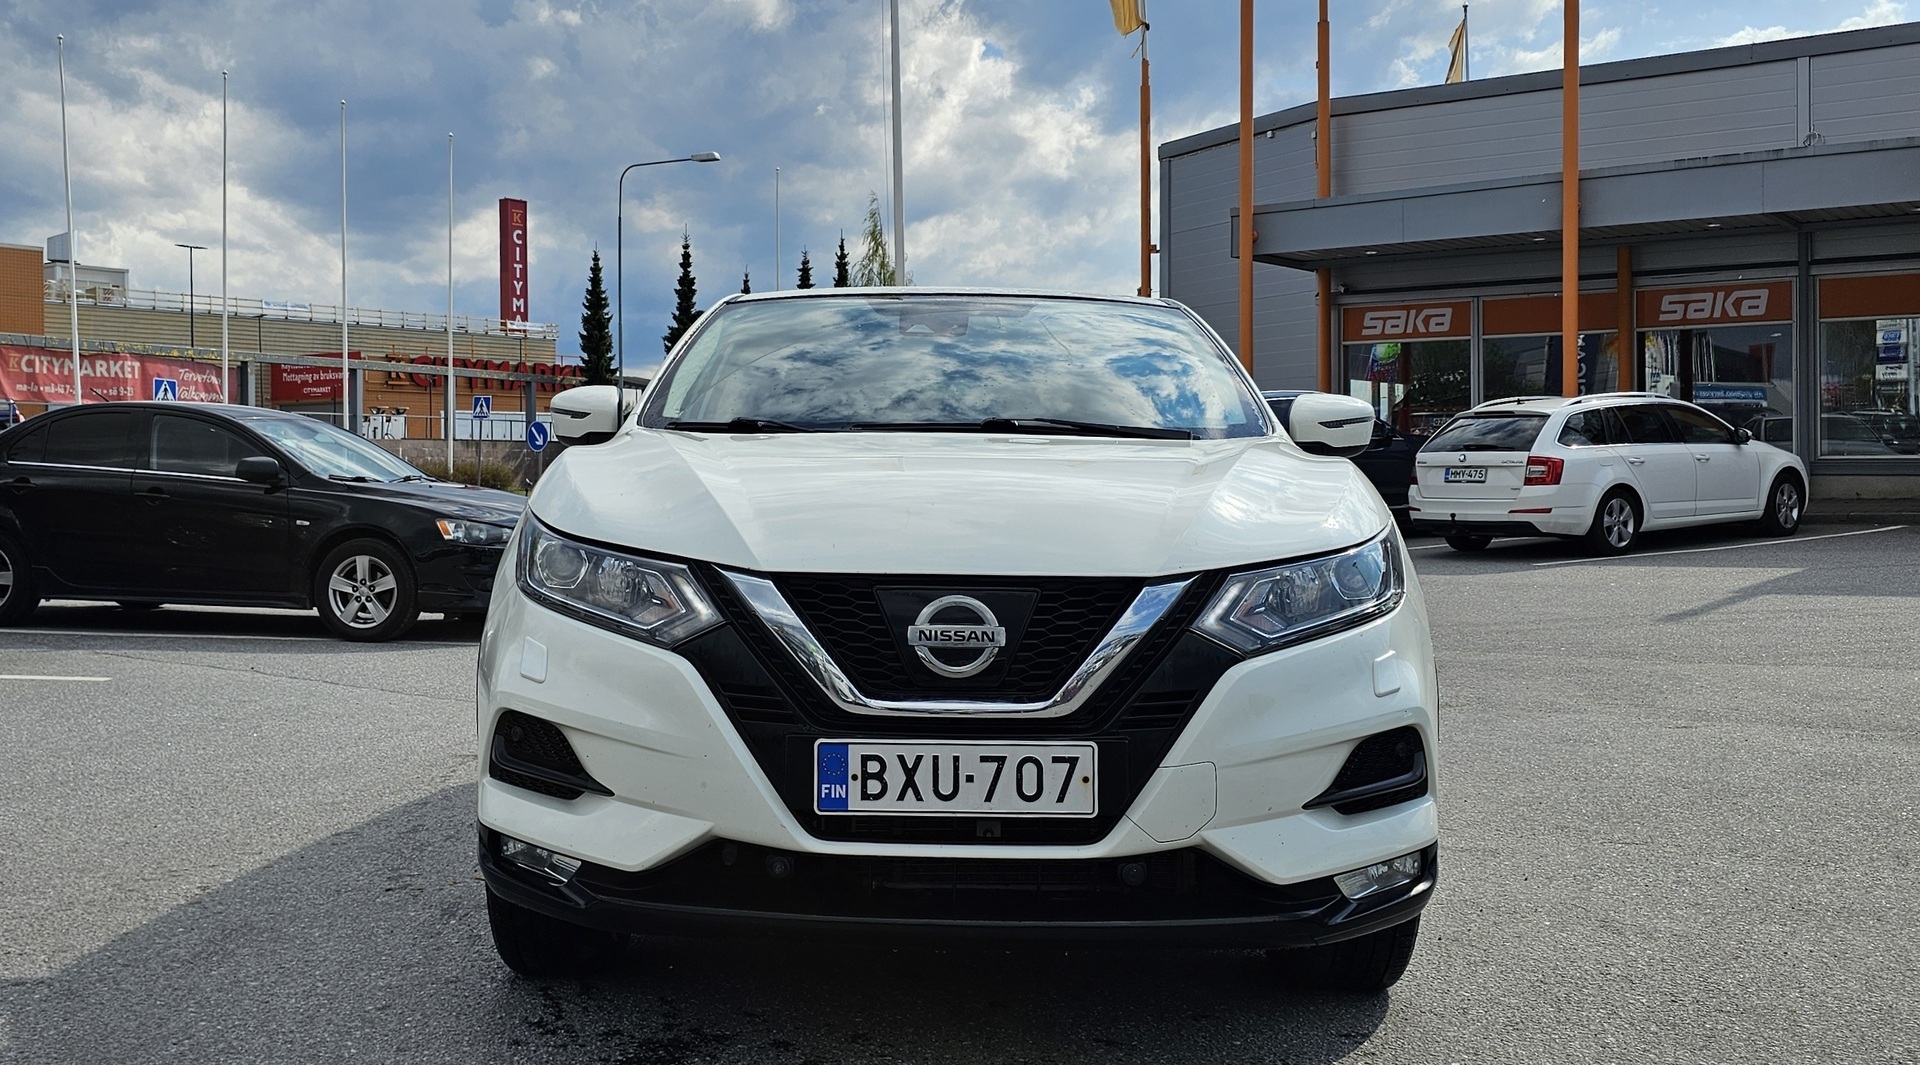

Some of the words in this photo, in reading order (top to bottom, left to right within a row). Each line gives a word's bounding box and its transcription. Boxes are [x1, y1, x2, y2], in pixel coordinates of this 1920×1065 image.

[303, 386, 332, 394] CITYMARKET
[1450, 469, 1484, 479] MMY-475
[918, 629, 995, 643] NISSAN
[860, 753, 1081, 804] BXU-707
[821, 784, 847, 799] FIN
